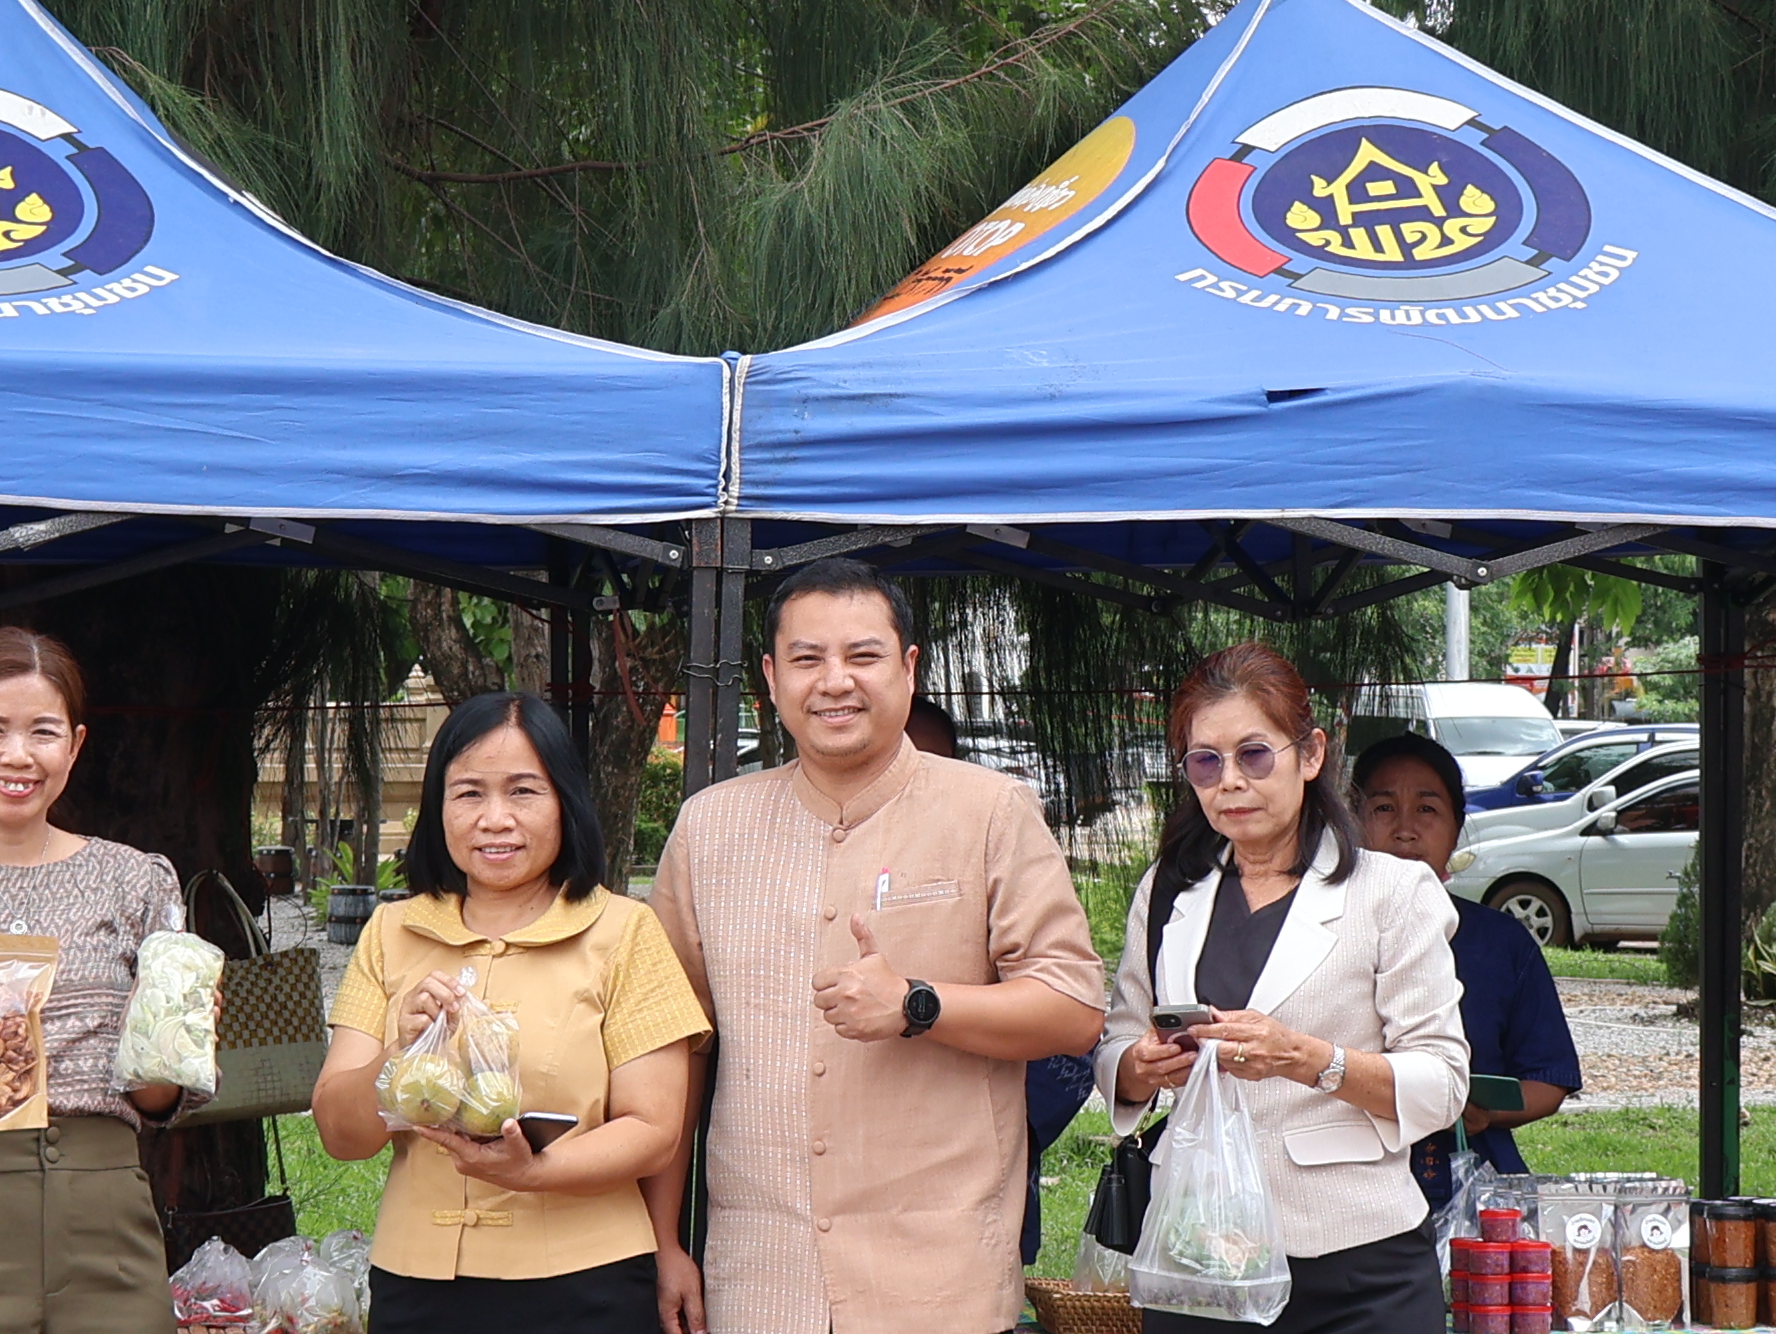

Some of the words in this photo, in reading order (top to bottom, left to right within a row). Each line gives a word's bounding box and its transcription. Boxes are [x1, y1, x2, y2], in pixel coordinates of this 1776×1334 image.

[1174, 245, 1638, 327] กรมการพัฒนาชุมชน
